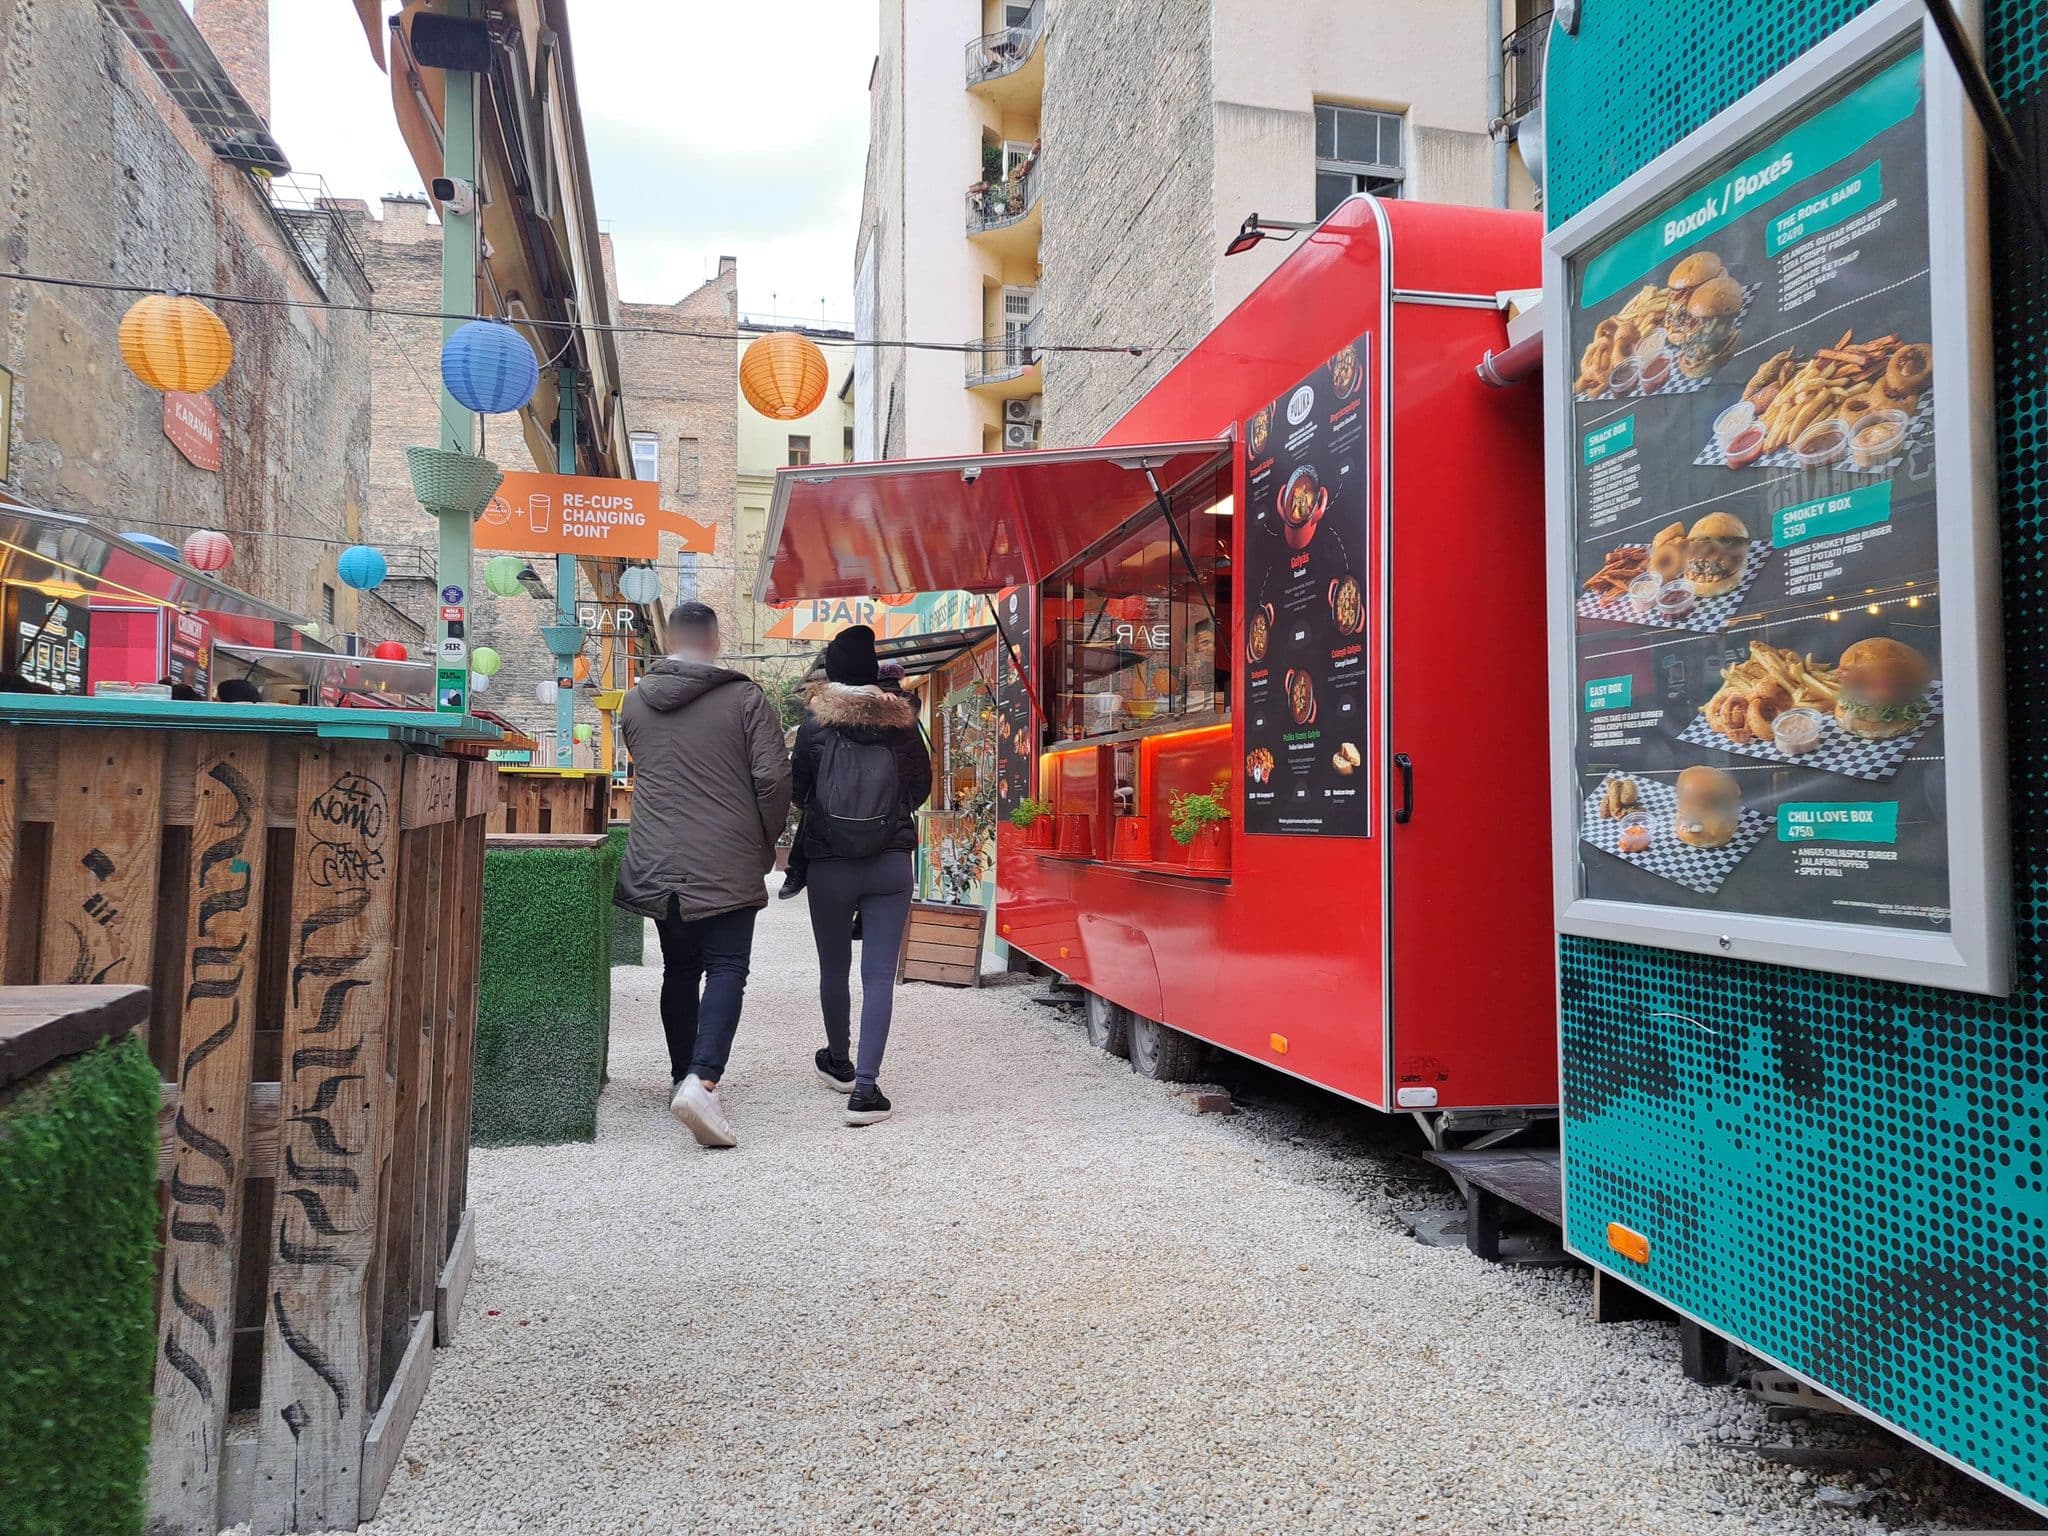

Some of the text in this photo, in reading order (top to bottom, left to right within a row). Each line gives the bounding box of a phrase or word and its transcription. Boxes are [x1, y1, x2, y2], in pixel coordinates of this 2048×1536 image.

[1663, 197, 1719, 246] Boxok
[1734, 150, 1794, 206] Boxes
[1777, 180, 1862, 232] THE ROCK BAND
[1867, 199, 1898, 225] BURGER
[1800, 248, 1827, 265] CRISPY
[1829, 234, 1851, 251] FRIES
[1851, 217, 1882, 241] BASKET
[563, 493, 634, 510] RE-CUPS
[1783, 497, 1852, 525] SMOKEY BOX
[563, 509, 646, 527] CHANGING
[563, 525, 611, 540] POINT
[1812, 538, 1845, 552] SMOKEY
[1845, 534, 1861, 545] BBQ
[1861, 525, 1893, 540] BURGER
[1789, 543, 1864, 568] SWEET POTATO FRIES
[1811, 560, 1834, 572] RINGS
[579, 608, 634, 631] BAR
[812, 599, 876, 625] BAR
[1590, 685, 1607, 697] EASY
[1788, 811, 1873, 823] CHILI LOVE BOX
[1789, 826, 1814, 838] 4750
[1799, 848, 1825, 857] ANGUS
[1868, 851, 1898, 860] BURGER
[1800, 868, 1843, 877] SPICY CHILI
